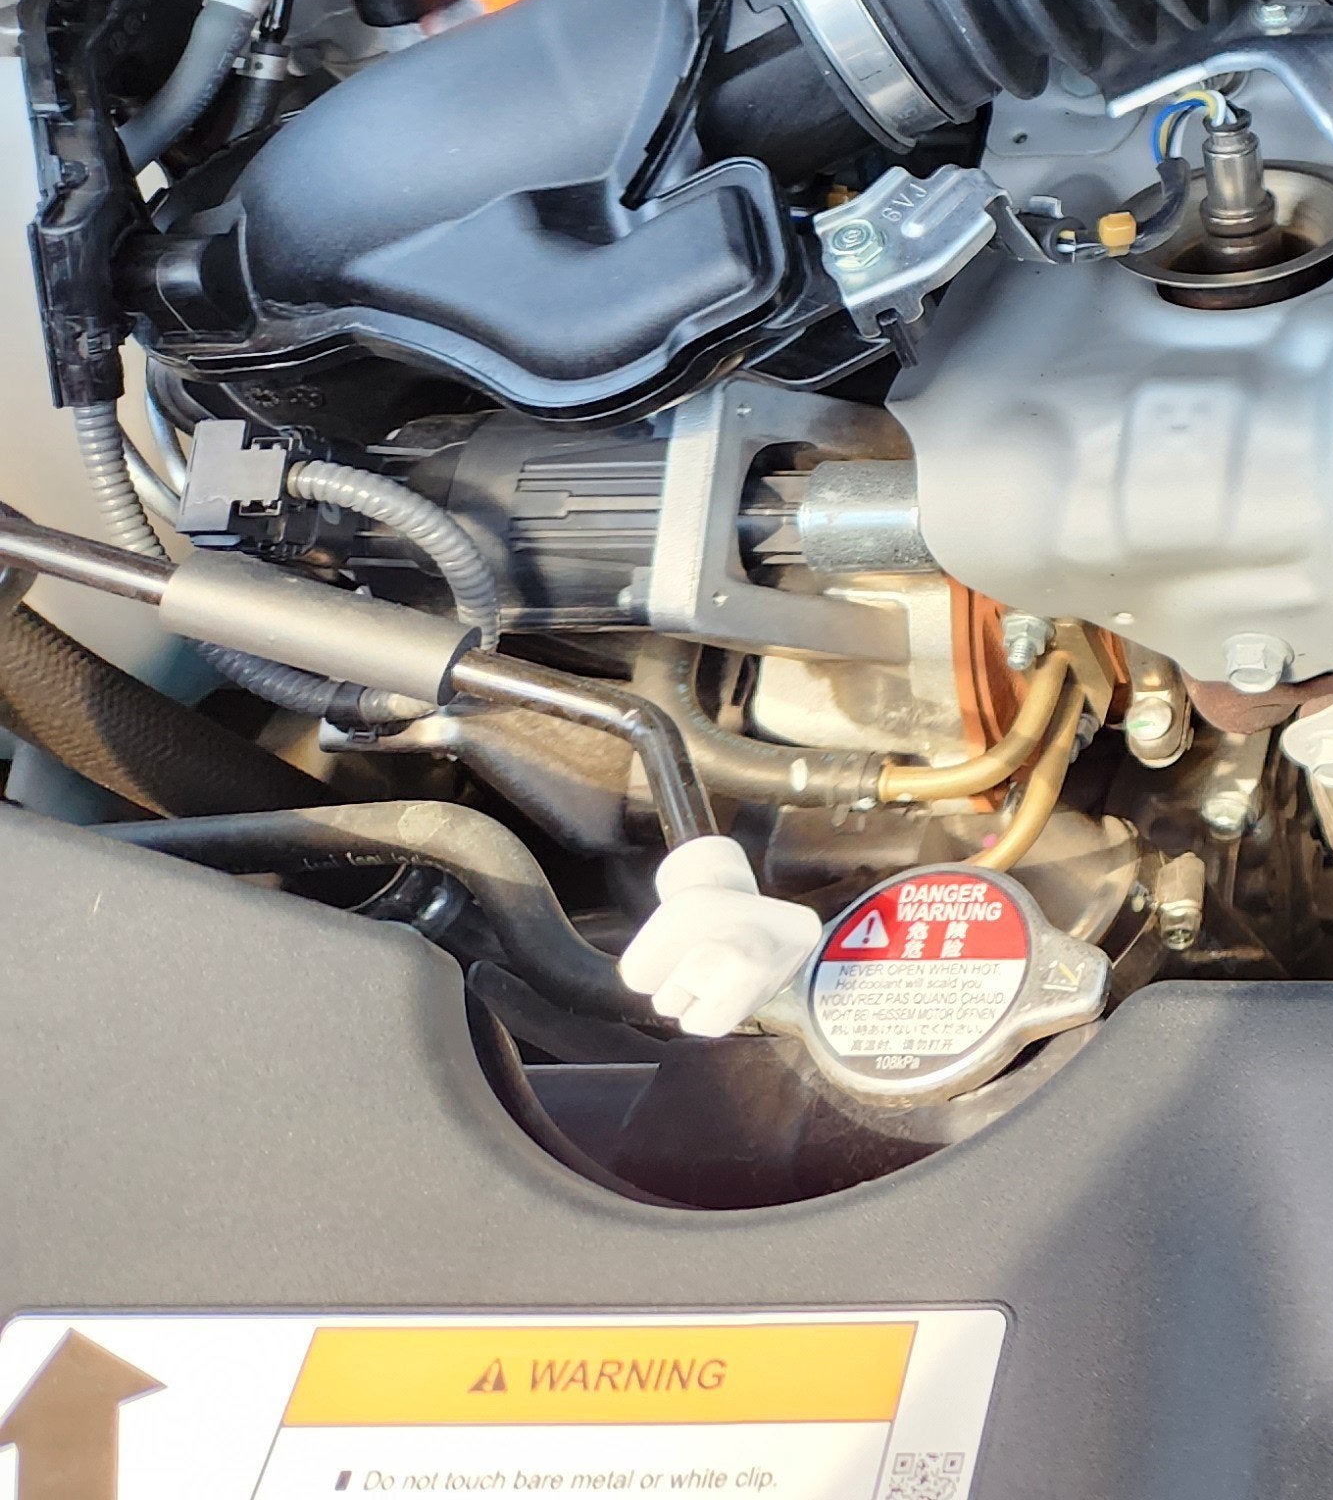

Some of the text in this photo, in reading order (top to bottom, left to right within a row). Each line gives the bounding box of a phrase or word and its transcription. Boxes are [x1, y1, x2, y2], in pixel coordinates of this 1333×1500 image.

[882, 182, 928, 222] 6VJ
[900, 883, 988, 903] DANGER
[896, 901, 1002, 922] WARNUNG
[839, 964, 884, 977] NEVER
[887, 964, 926, 976] OPEN
[928, 963, 968, 976] WHEN
[835, 978, 856, 991] Hot
[858, 979, 902, 990] coolant
[905, 978, 924, 989] will
[927, 977, 957, 989] scald
[819, 993, 882, 1007] N'OUVREZ
[885, 992, 910, 1005] PAS
[913, 992, 957, 1005] QUAND
[821, 1009, 852, 1022] NICHT
[918, 1008, 955, 1020] MOTOR
[875, 1055, 921, 1070] 108kPa
[530, 1357, 729, 1393] WARNING
[362, 1465, 778, 1493] Do not touch bare metal or white clip.
